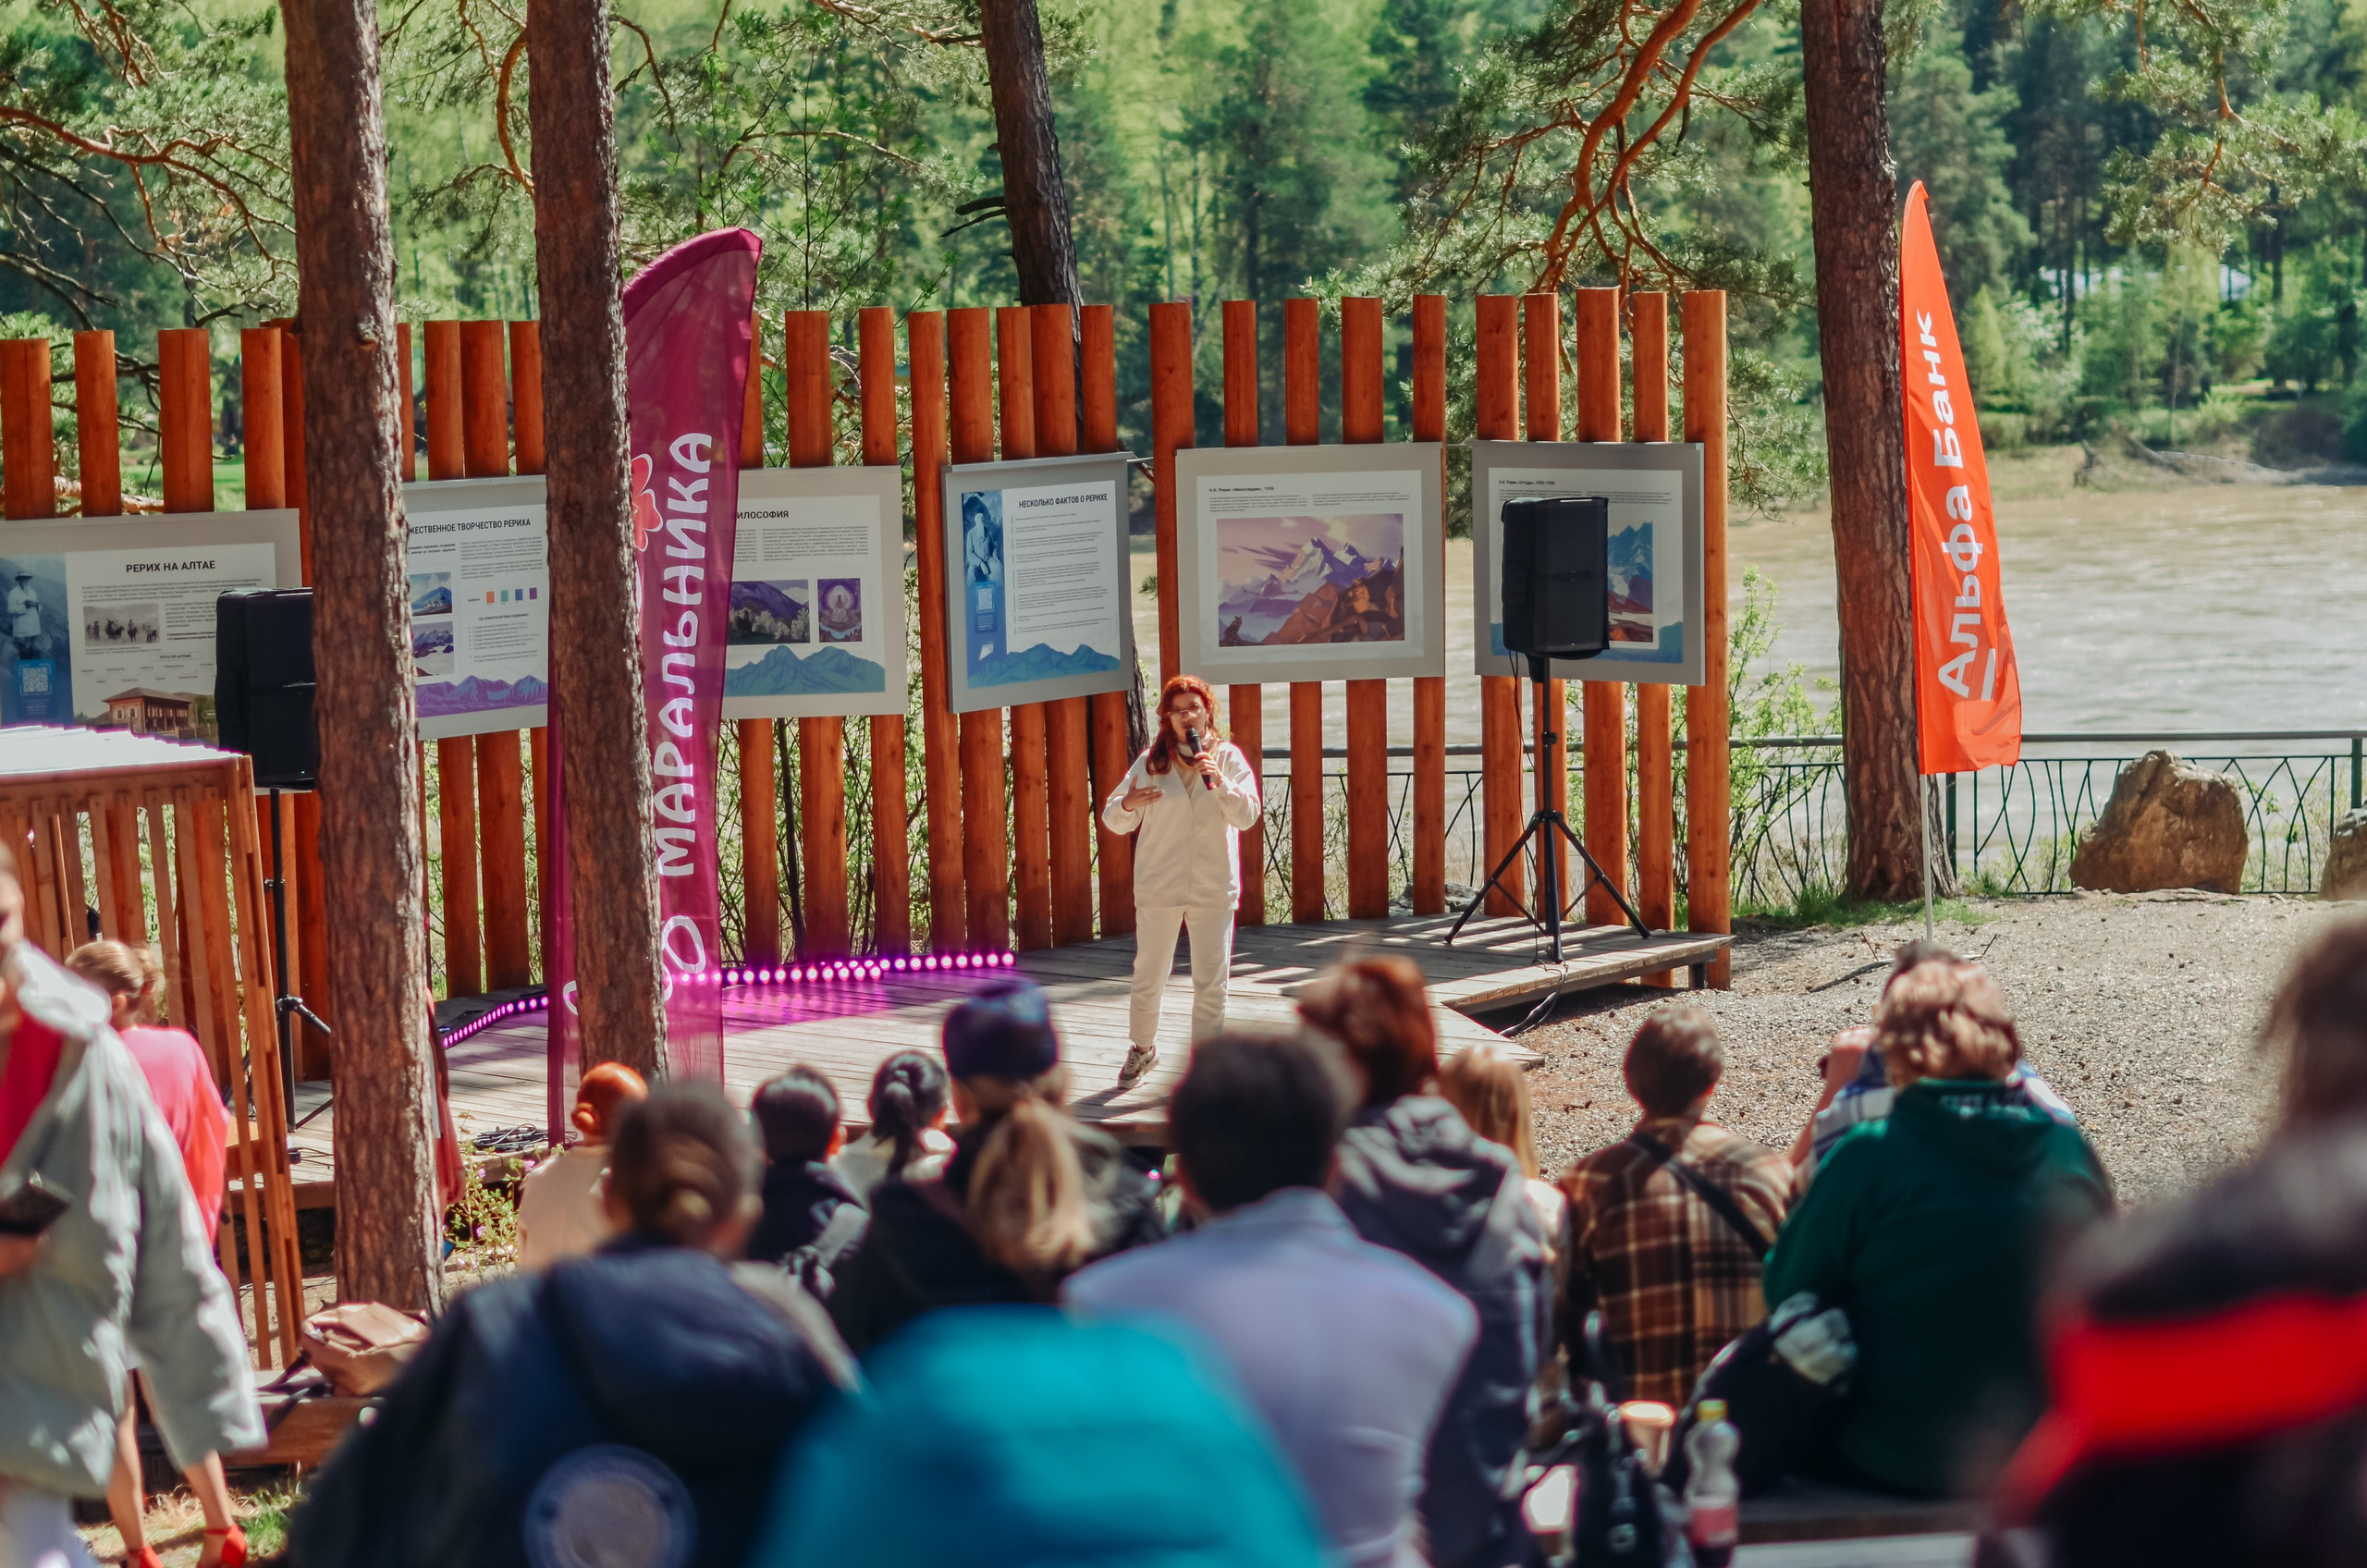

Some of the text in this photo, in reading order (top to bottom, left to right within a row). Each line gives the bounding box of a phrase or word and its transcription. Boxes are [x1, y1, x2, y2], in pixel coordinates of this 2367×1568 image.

[1019, 493, 1108, 508] НЕСКОЛЬКО ФАКТОВ О РЕРИХЕ
[1916, 308, 1983, 700] Альфа Банк
[737, 510, 789, 520] ИЛОСОФИЯ
[457, 520, 502, 531] ТВОРЧЕСТВО
[503, 518, 531, 528] РЕРИХА
[126, 560, 215, 573] РЕРИХ НА АЛТАЕ
[653, 432, 712, 877] МАРАЛЬНИКА
